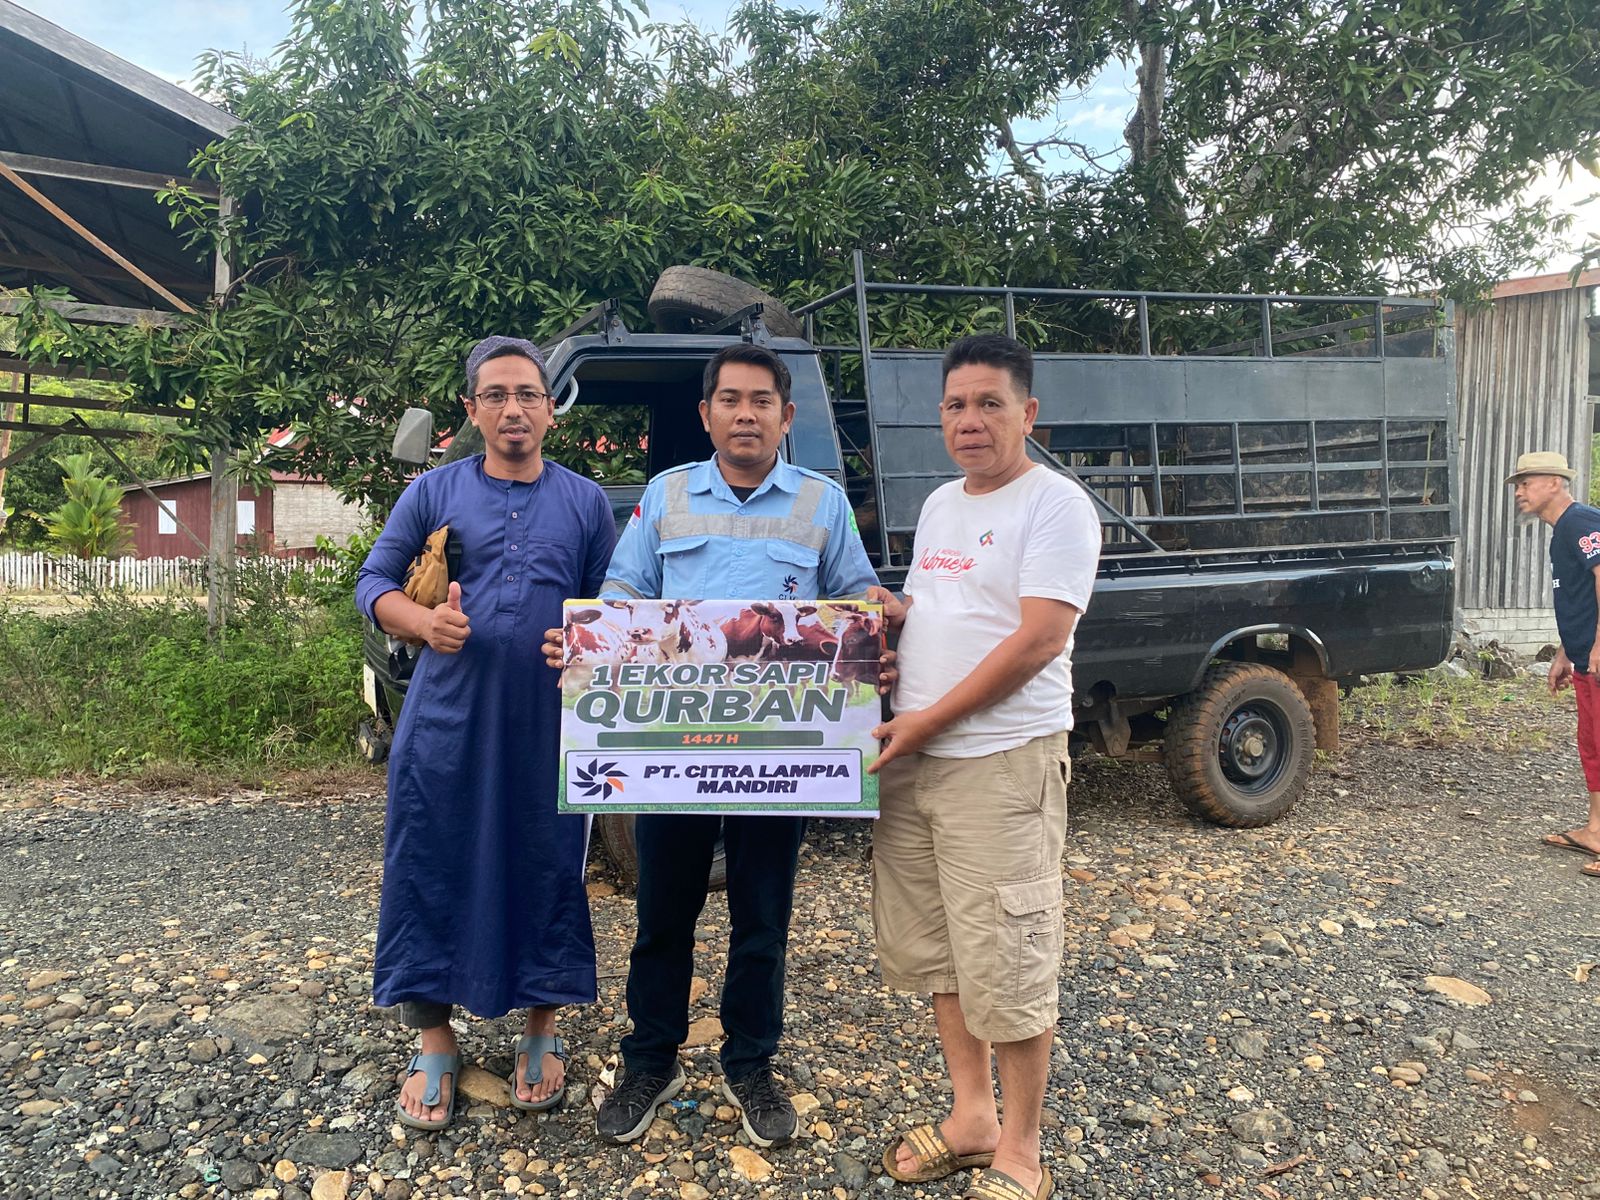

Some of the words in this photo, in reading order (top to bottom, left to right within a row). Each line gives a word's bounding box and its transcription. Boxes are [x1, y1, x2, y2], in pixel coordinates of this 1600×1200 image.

[592, 664, 611, 687] 1
[619, 664, 727, 687] EKOR
[733, 663, 828, 685] SAPI
[575, 688, 848, 728] QURBAN
[682, 733, 723, 745] 1447
[727, 733, 739, 744] H
[643, 764, 681, 779] PT.
[684, 764, 757, 778] CITRA
[758, 764, 850, 778] LAMPIA
[696, 780, 798, 794] MANDIRI
